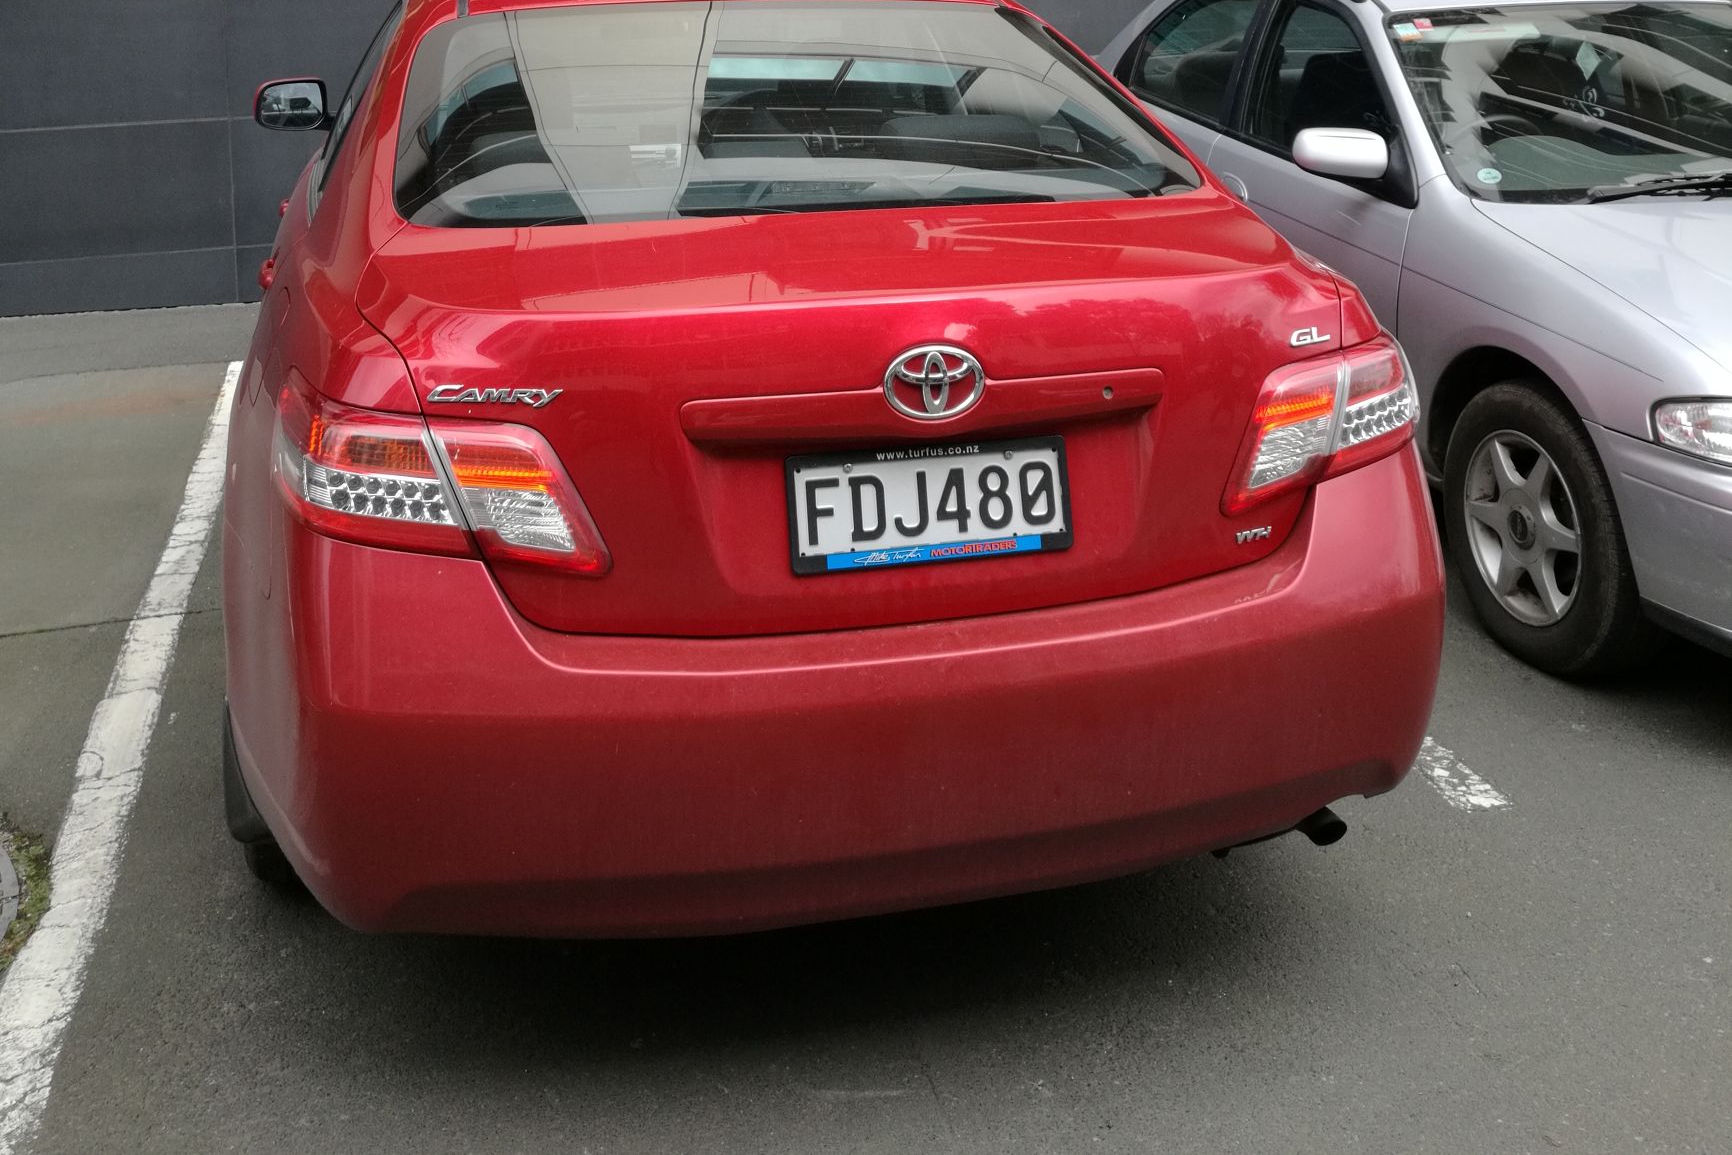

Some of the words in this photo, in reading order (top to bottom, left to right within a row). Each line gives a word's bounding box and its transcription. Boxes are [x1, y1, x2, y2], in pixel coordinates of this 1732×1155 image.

[1290, 327, 1331, 347] GL
[427, 384, 564, 408] CAMRY
[876, 445, 980, 461] www.turfus.co.nz
[804, 461, 1056, 546] FDJ480
